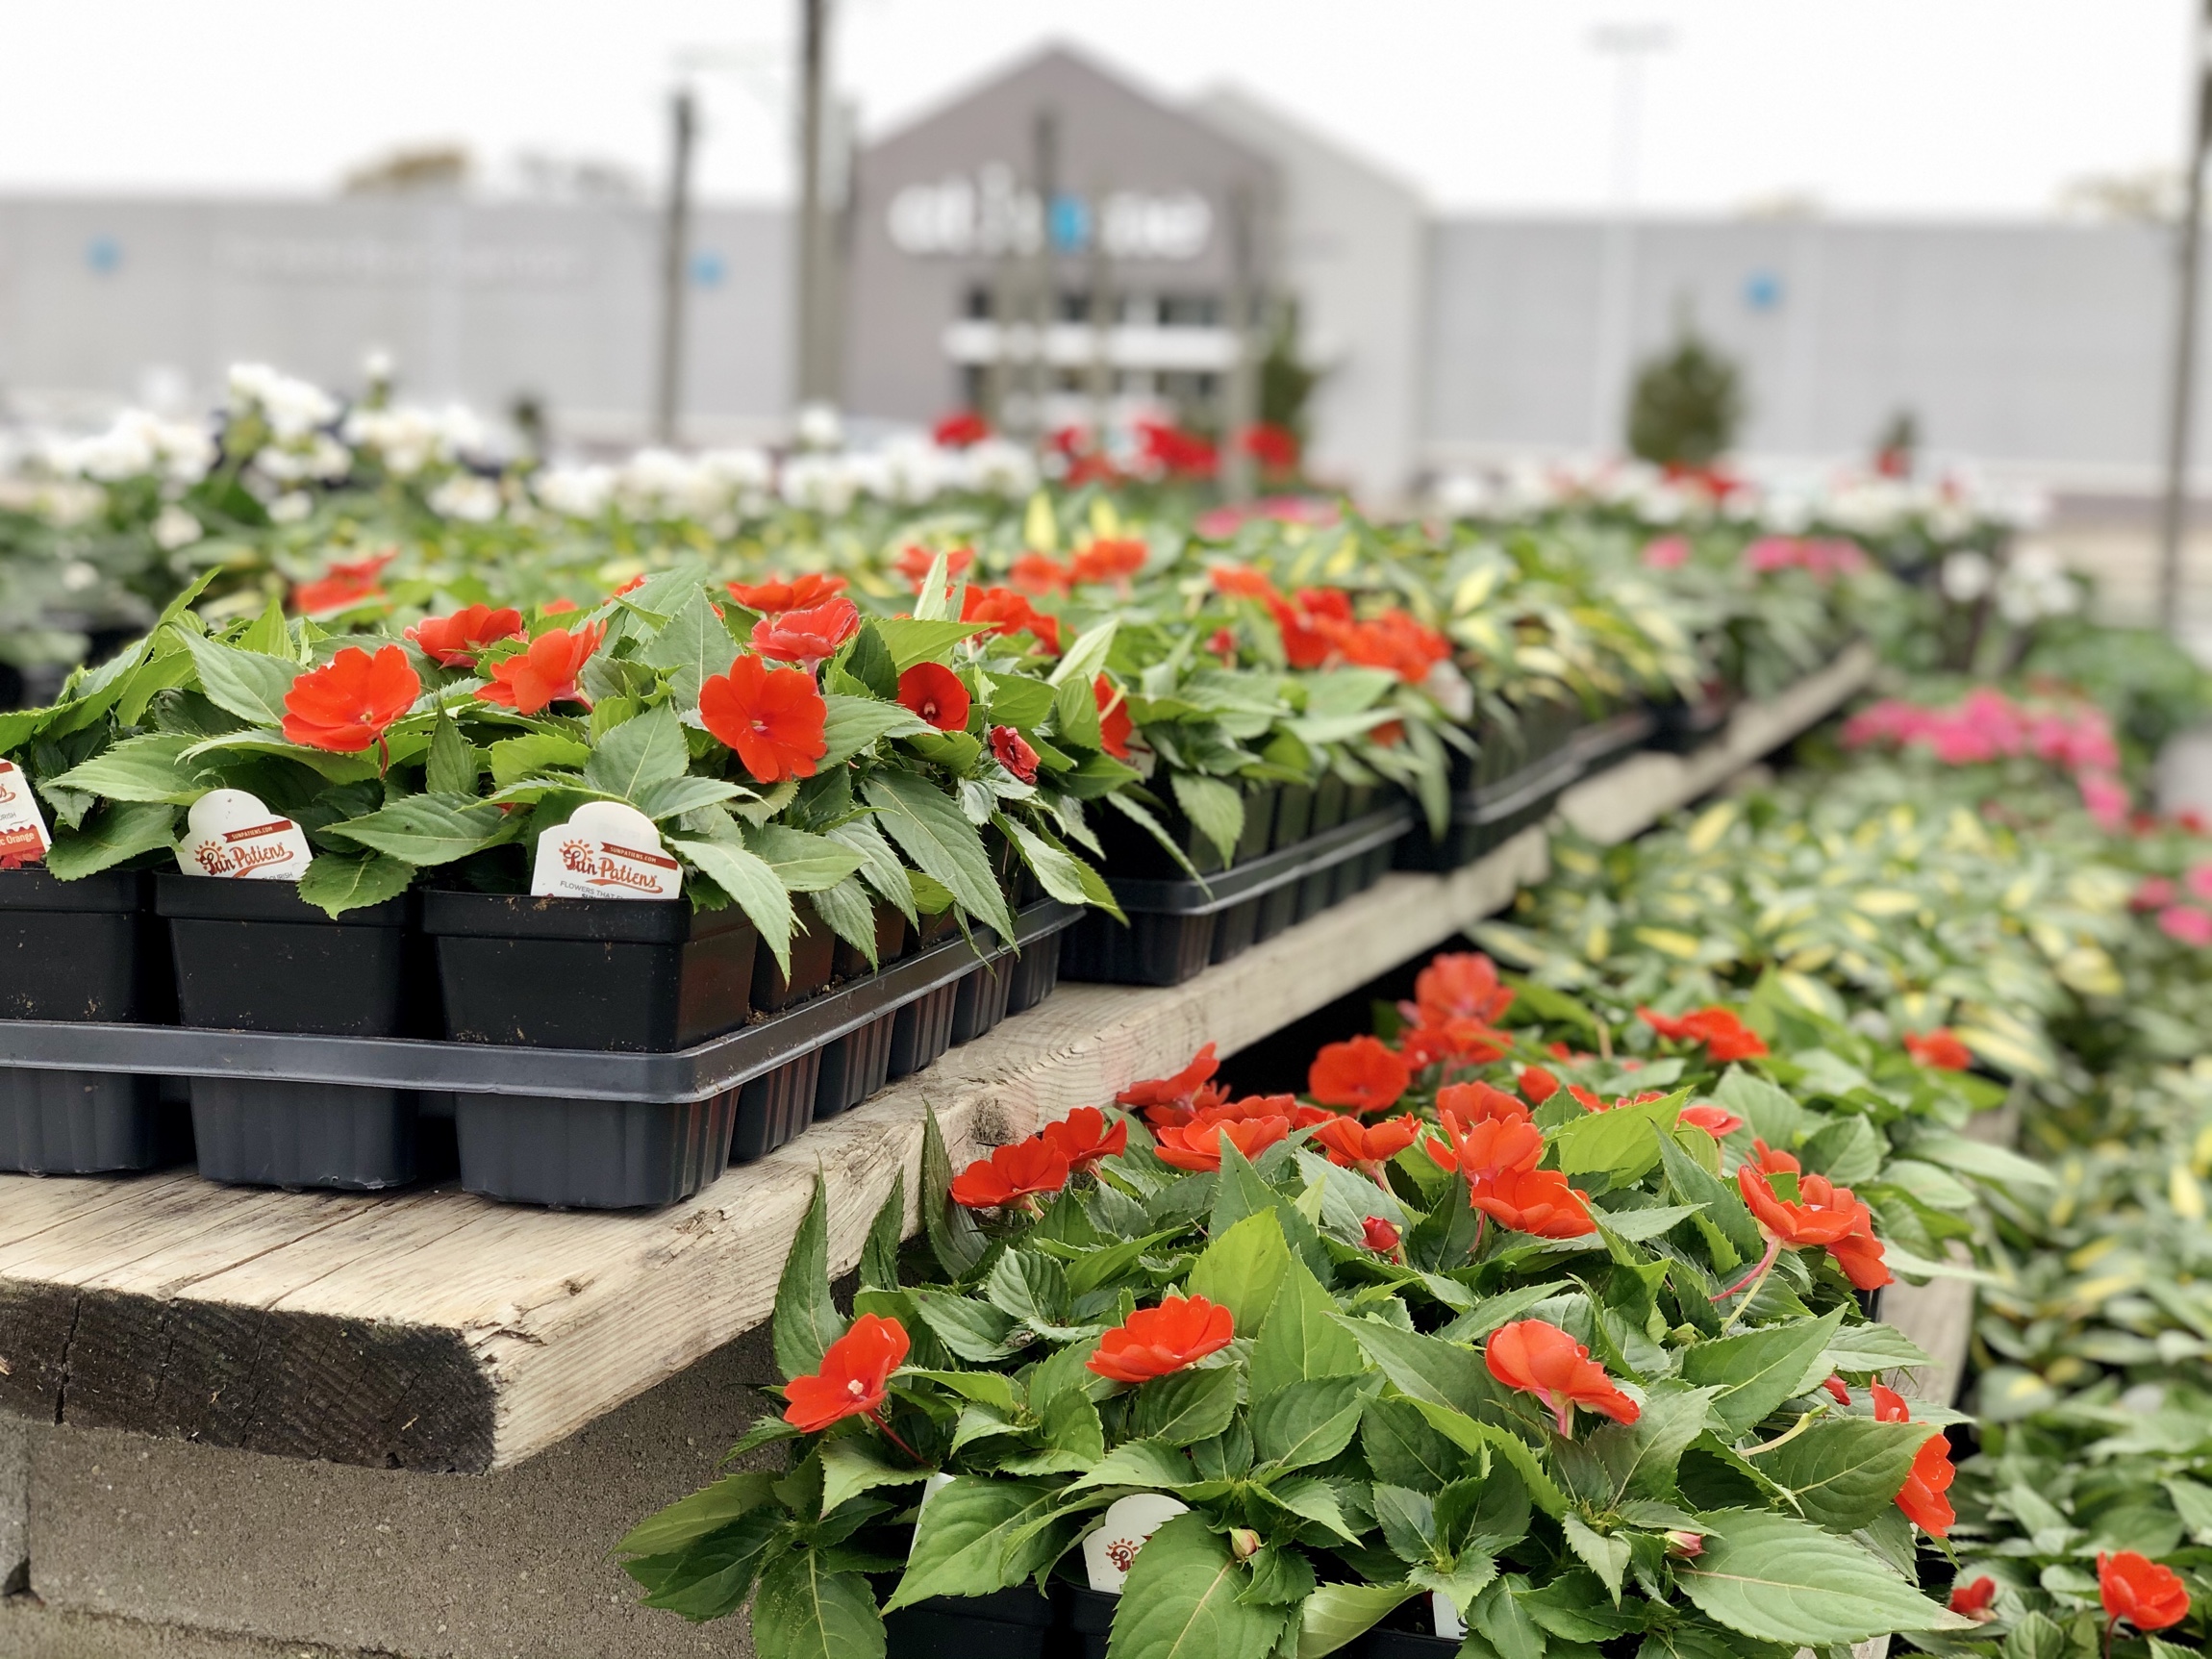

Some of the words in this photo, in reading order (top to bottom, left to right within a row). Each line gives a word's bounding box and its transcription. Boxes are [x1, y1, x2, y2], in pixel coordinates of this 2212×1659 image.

[6, 832, 35, 844] Orange
[231, 827, 273, 840] SUNPATIENS.COM
[610, 846, 657, 864] SUNPATIENS.COM
[560, 881, 594, 894] FLOWERS
